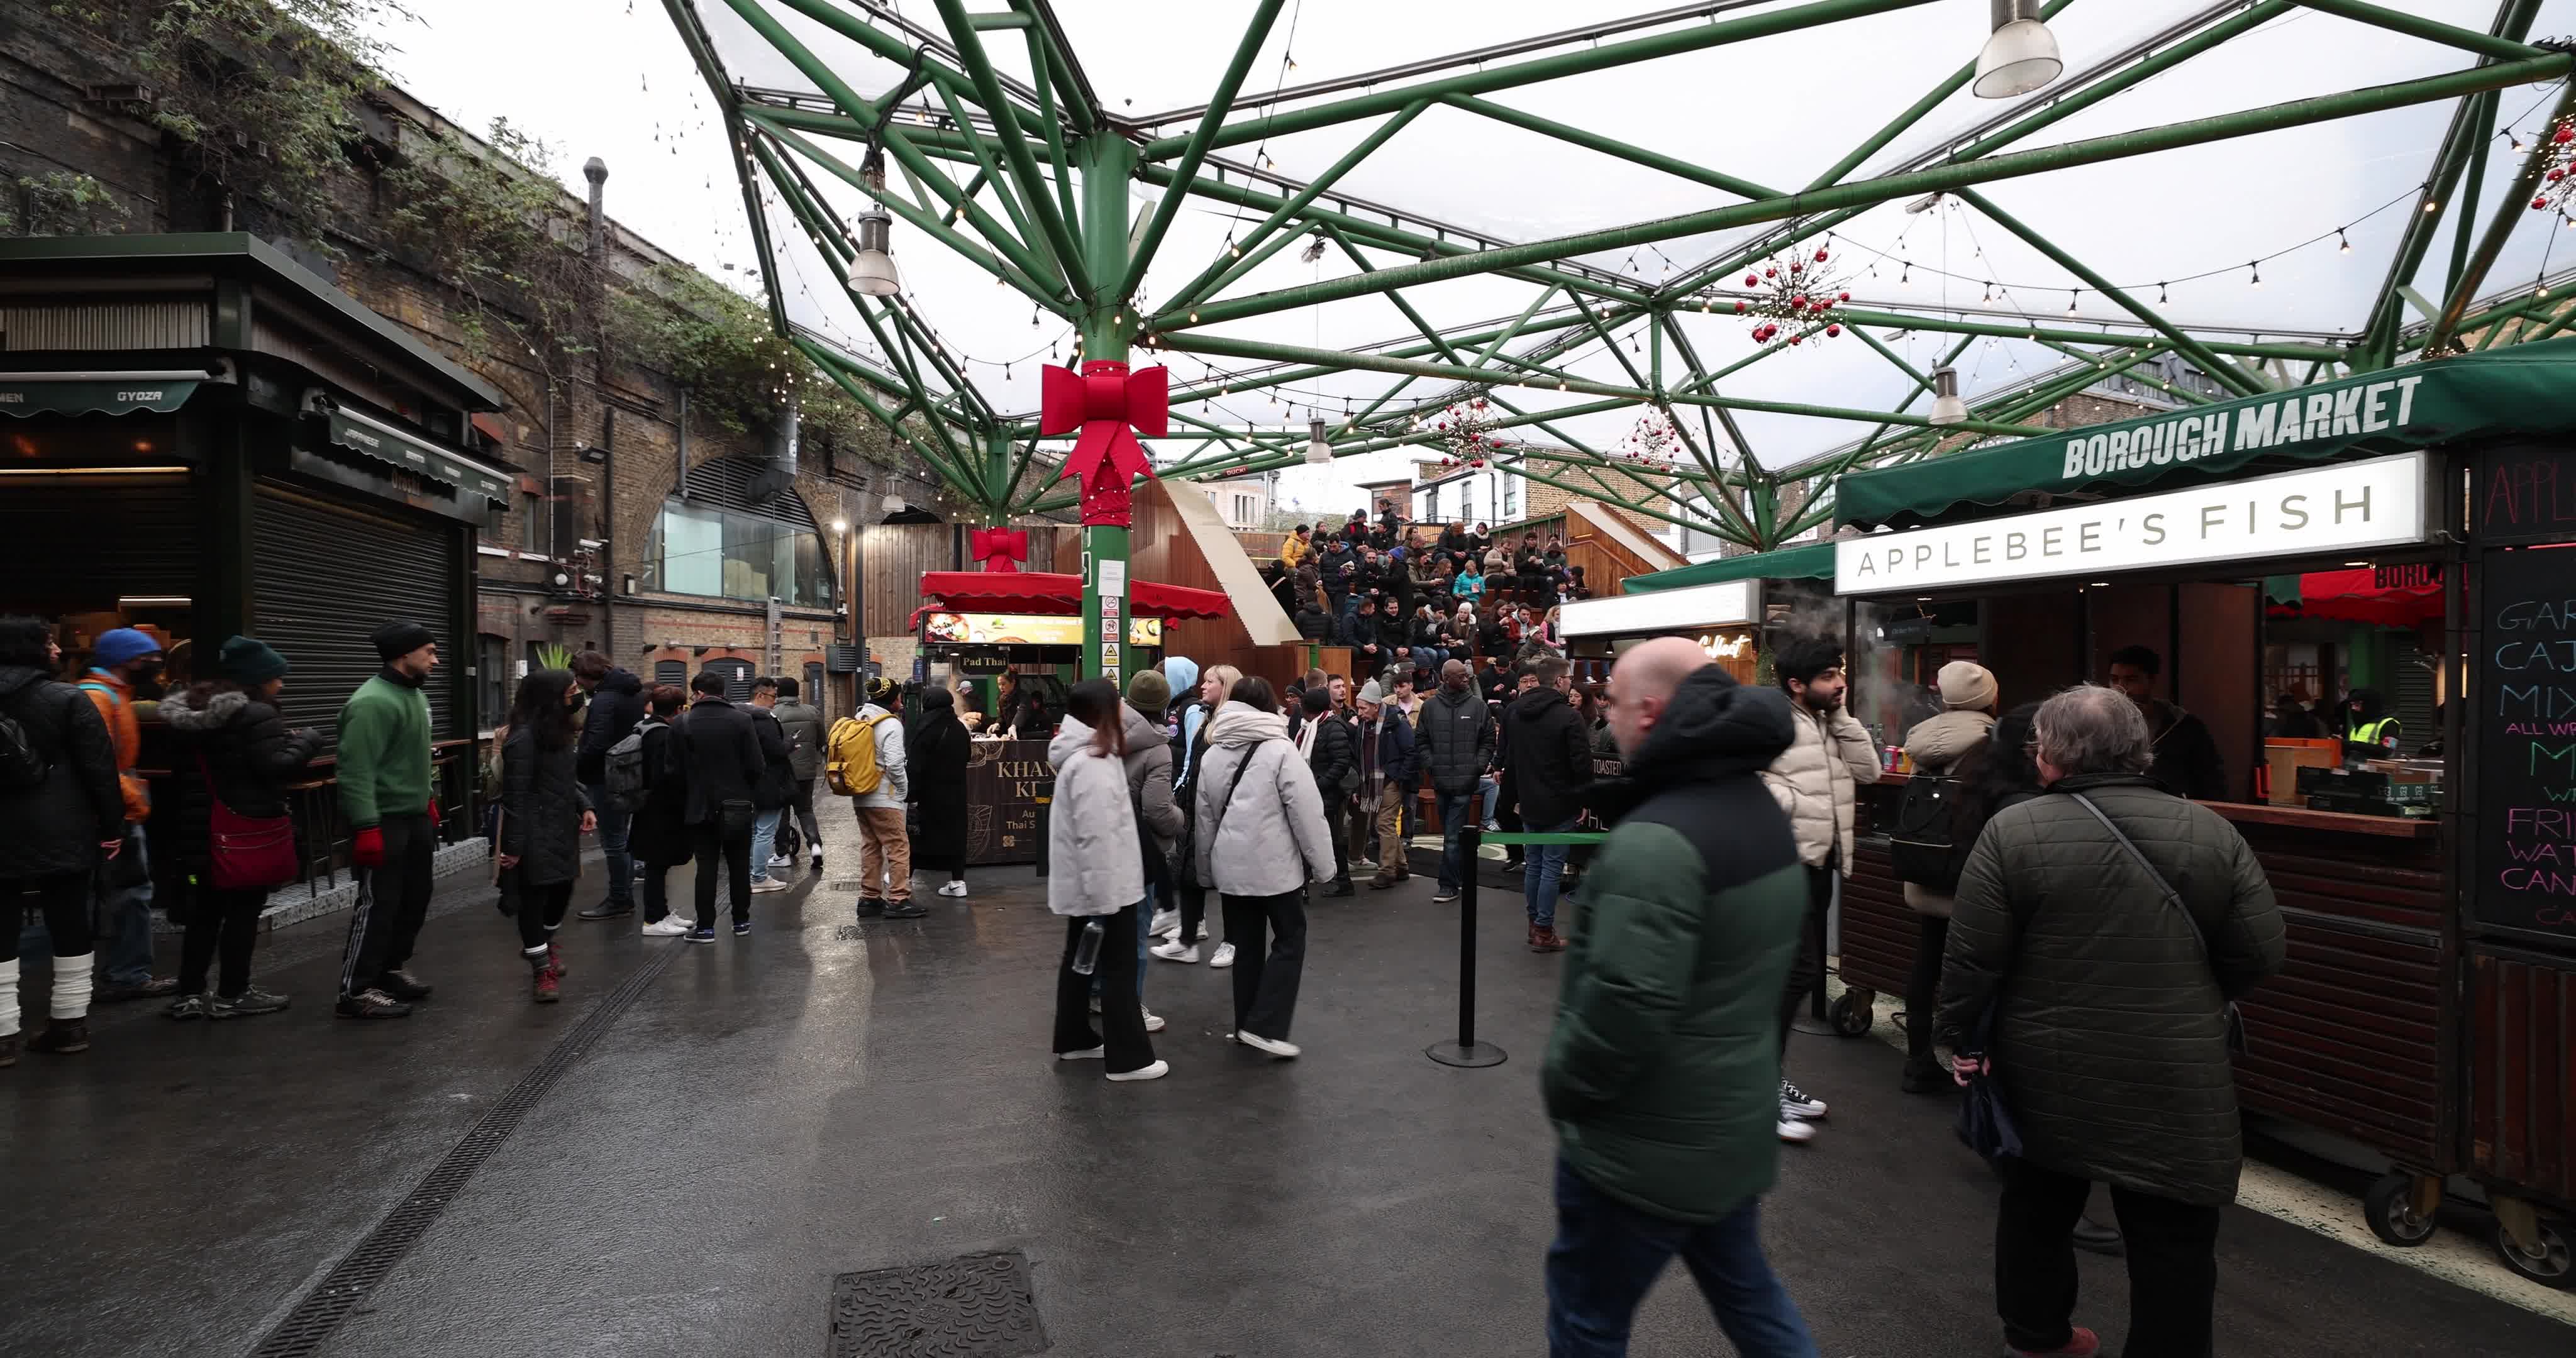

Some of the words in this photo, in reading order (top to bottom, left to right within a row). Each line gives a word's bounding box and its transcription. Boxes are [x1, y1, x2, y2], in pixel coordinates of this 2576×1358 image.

[117, 391, 163, 402] GYOZA
[2062, 412, 2228, 480] BOROUGH
[2233, 375, 2423, 452] MARKET
[1857, 513, 2167, 577] APPLEBEE'S
[2201, 485, 2372, 540] FISH
[963, 657, 981, 666] Pad
[983, 657, 1007, 666] Thai
[2505, 721, 2545, 735] ALL
[1593, 759, 1622, 775] TOASTED
[1006, 820, 1027, 829] Thai
[2501, 868, 2576, 895] CAN
